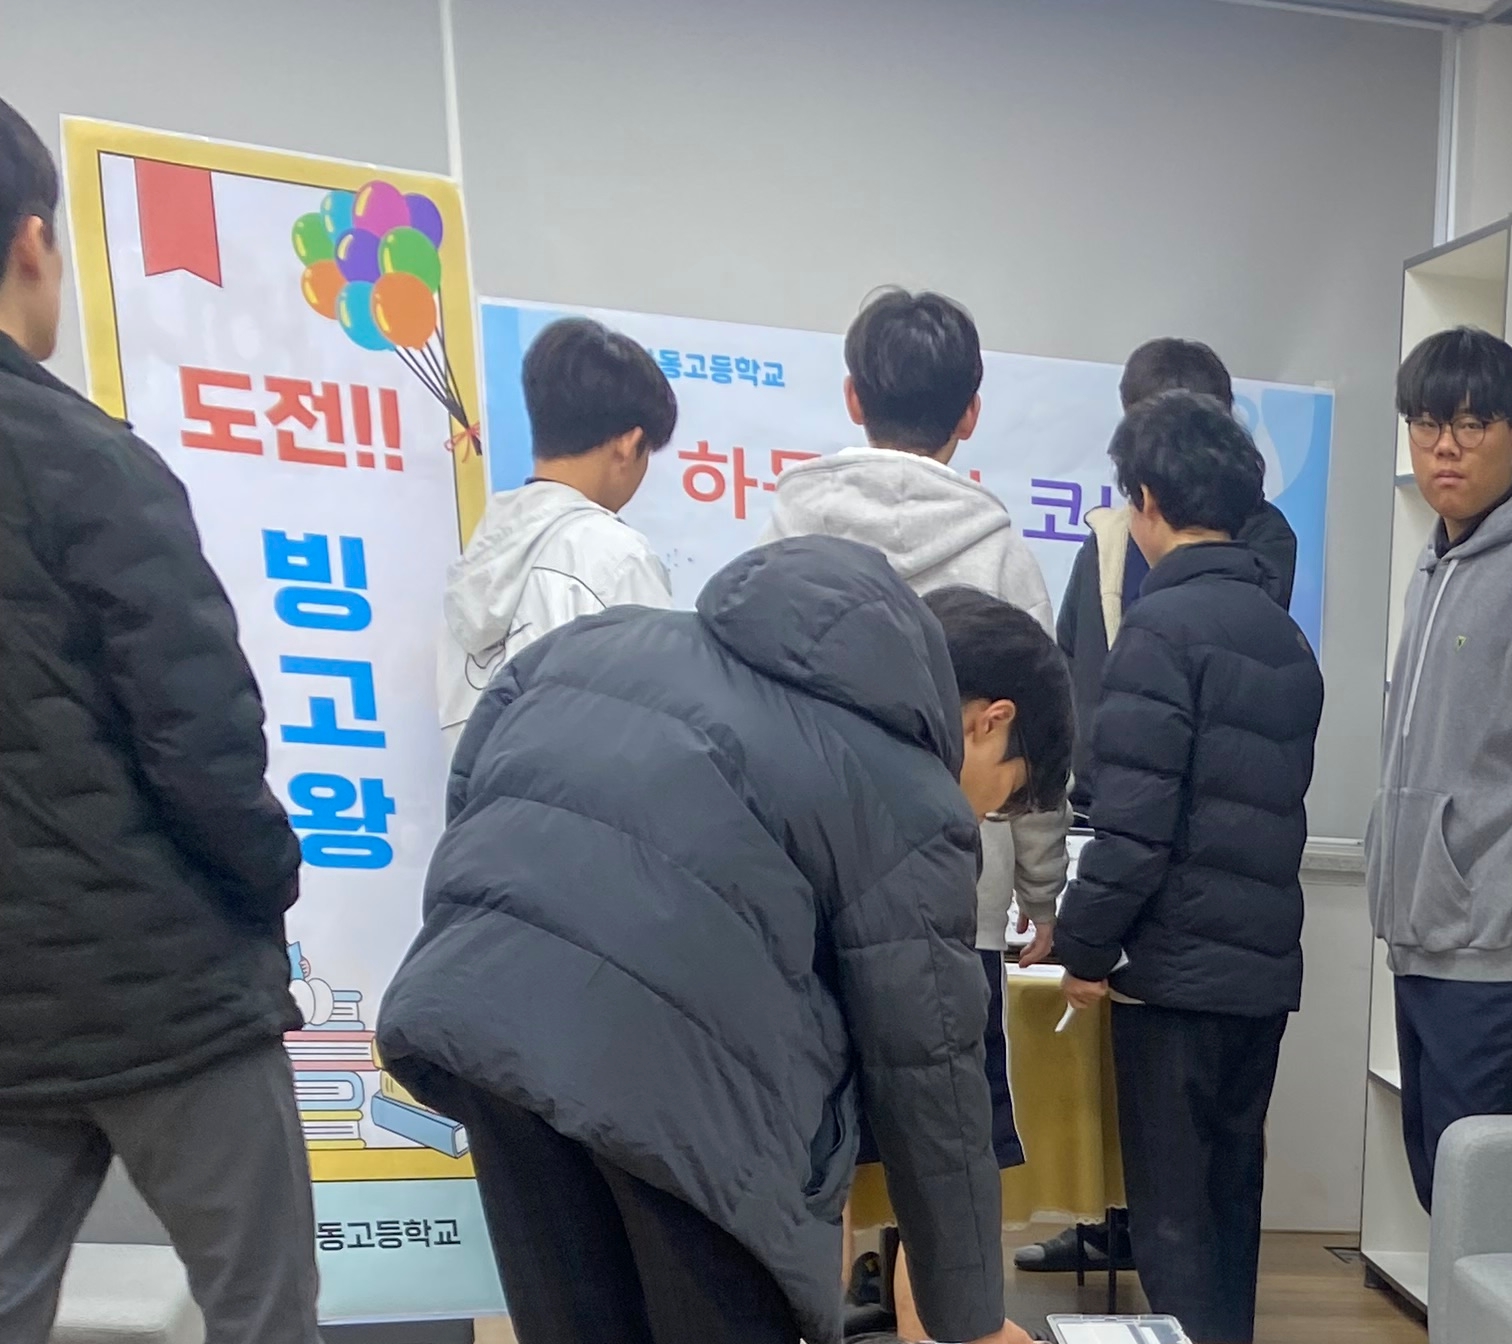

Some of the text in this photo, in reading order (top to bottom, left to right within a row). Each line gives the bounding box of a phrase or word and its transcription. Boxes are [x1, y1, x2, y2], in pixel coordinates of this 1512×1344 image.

[649, 348, 786, 388] 동고등학교
[179, 365, 405, 472] 도전!!
[261, 528, 397, 872] 빙고왕
[316, 1218, 461, 1251] 동고등학교
